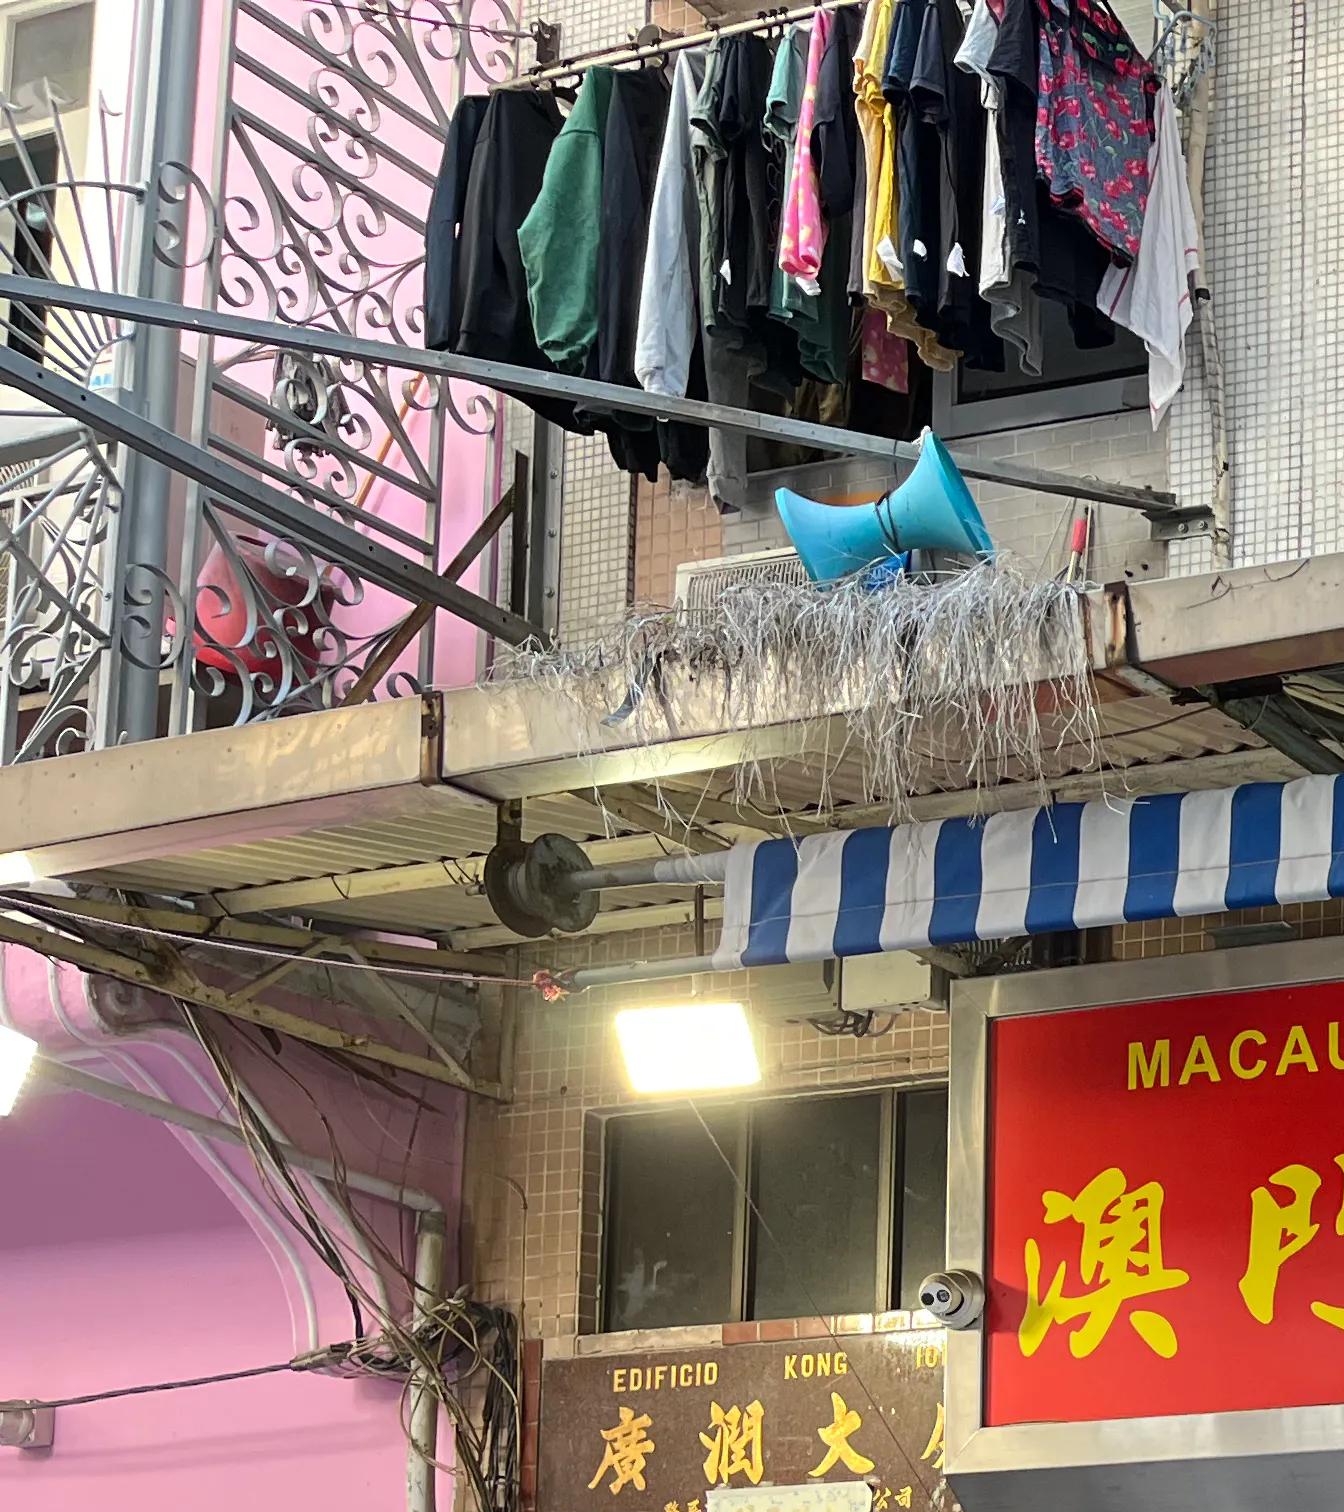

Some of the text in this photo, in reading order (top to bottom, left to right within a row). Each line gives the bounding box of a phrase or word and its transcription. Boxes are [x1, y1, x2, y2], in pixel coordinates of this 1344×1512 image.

[612, 1344, 946, 1393] EDIFICIO KONG IO
[588, 1391, 945, 1496] 廣潤大
